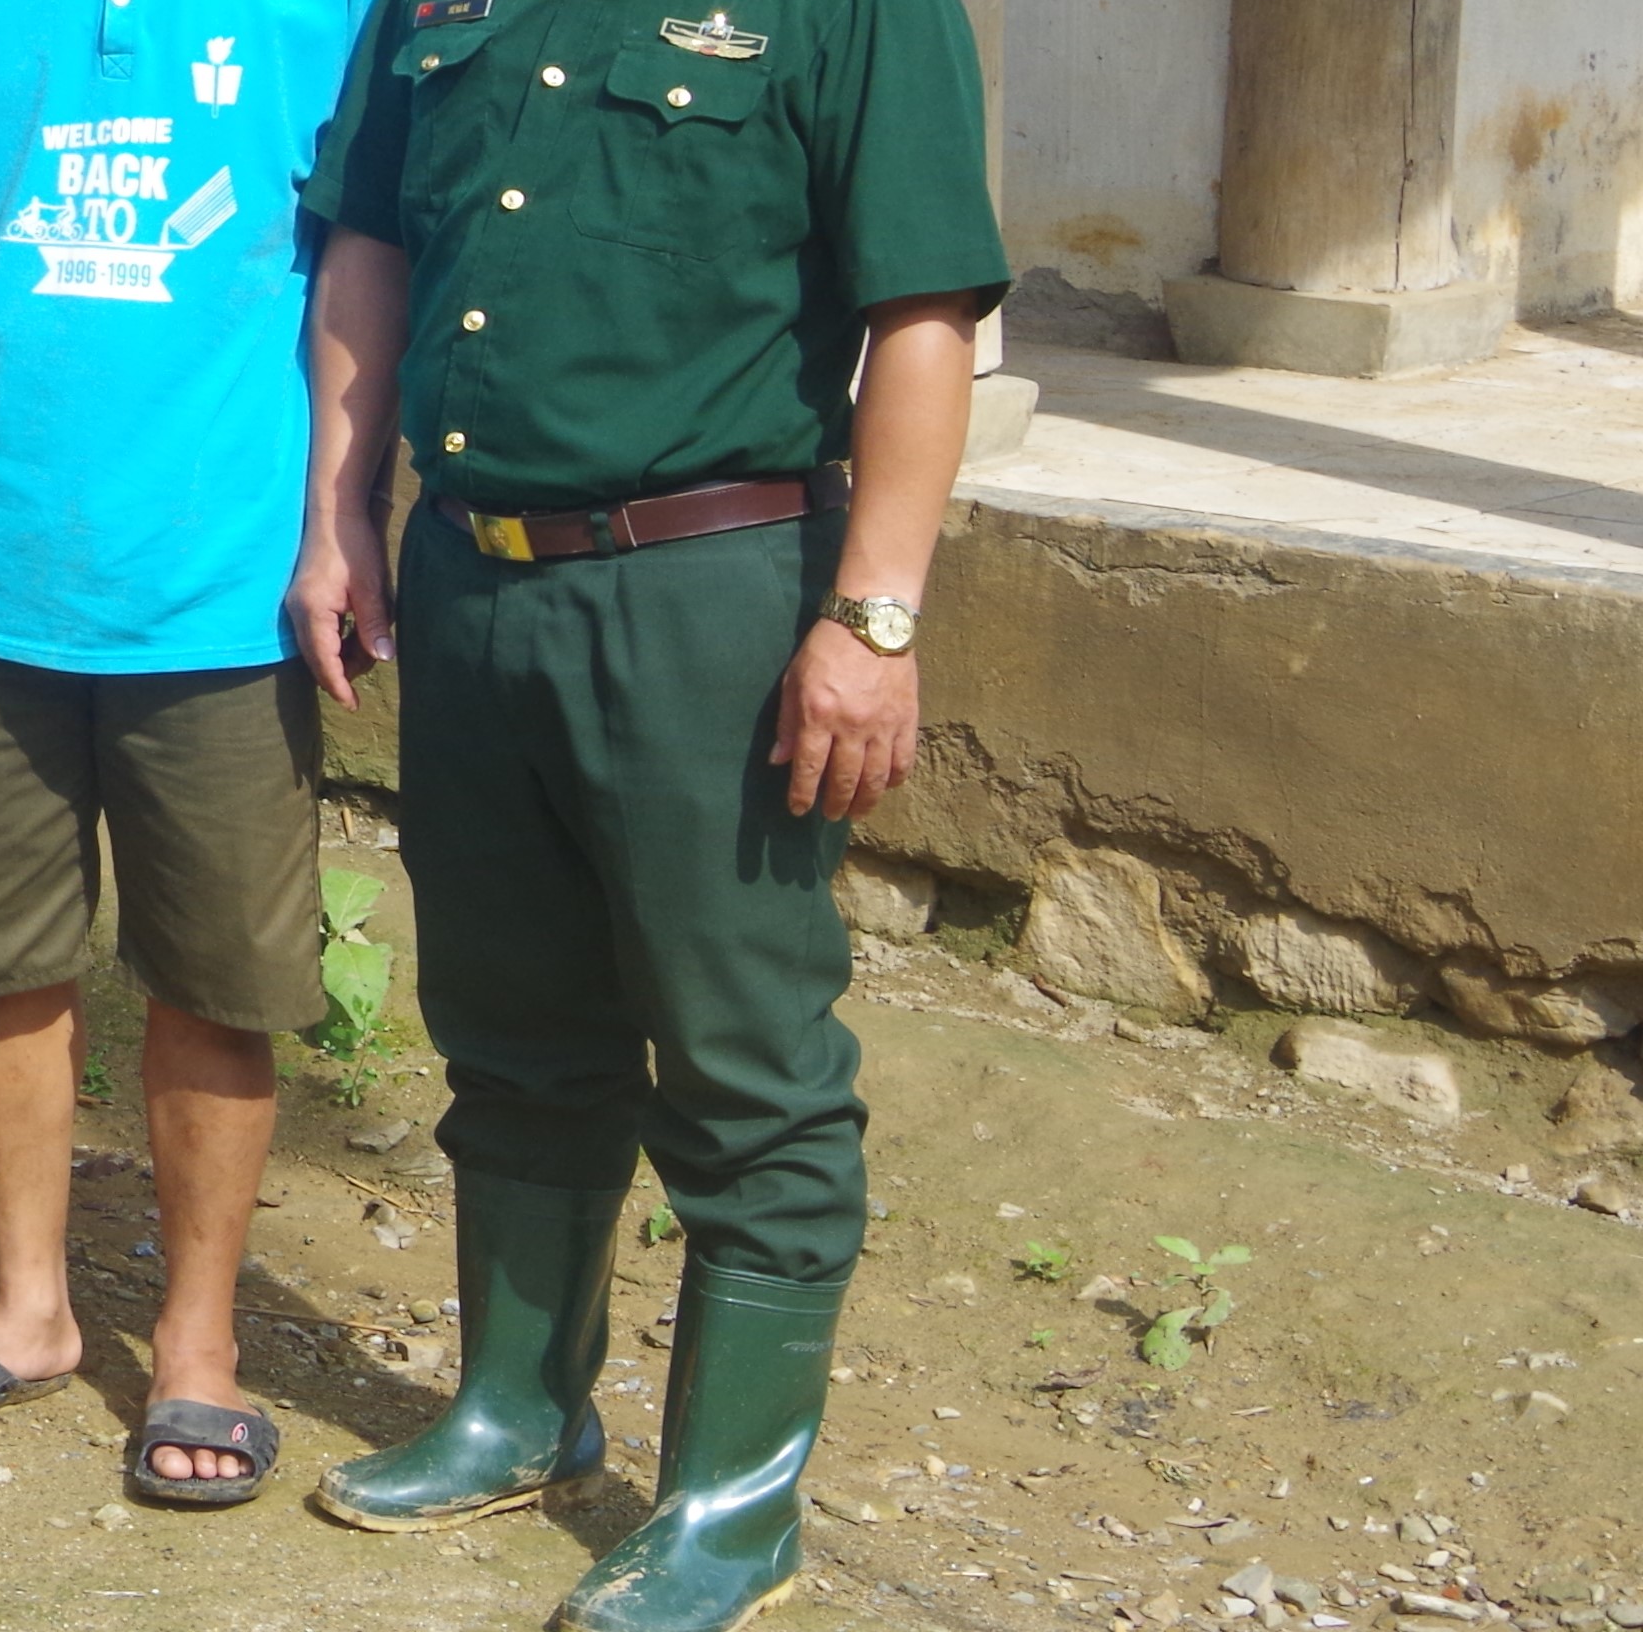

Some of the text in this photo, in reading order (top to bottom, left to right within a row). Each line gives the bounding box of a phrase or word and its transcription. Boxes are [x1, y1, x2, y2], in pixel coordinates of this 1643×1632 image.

[42, 117, 174, 151] WELCOME
[57, 152, 171, 201] BACK
[82, 198, 138, 245] TO
